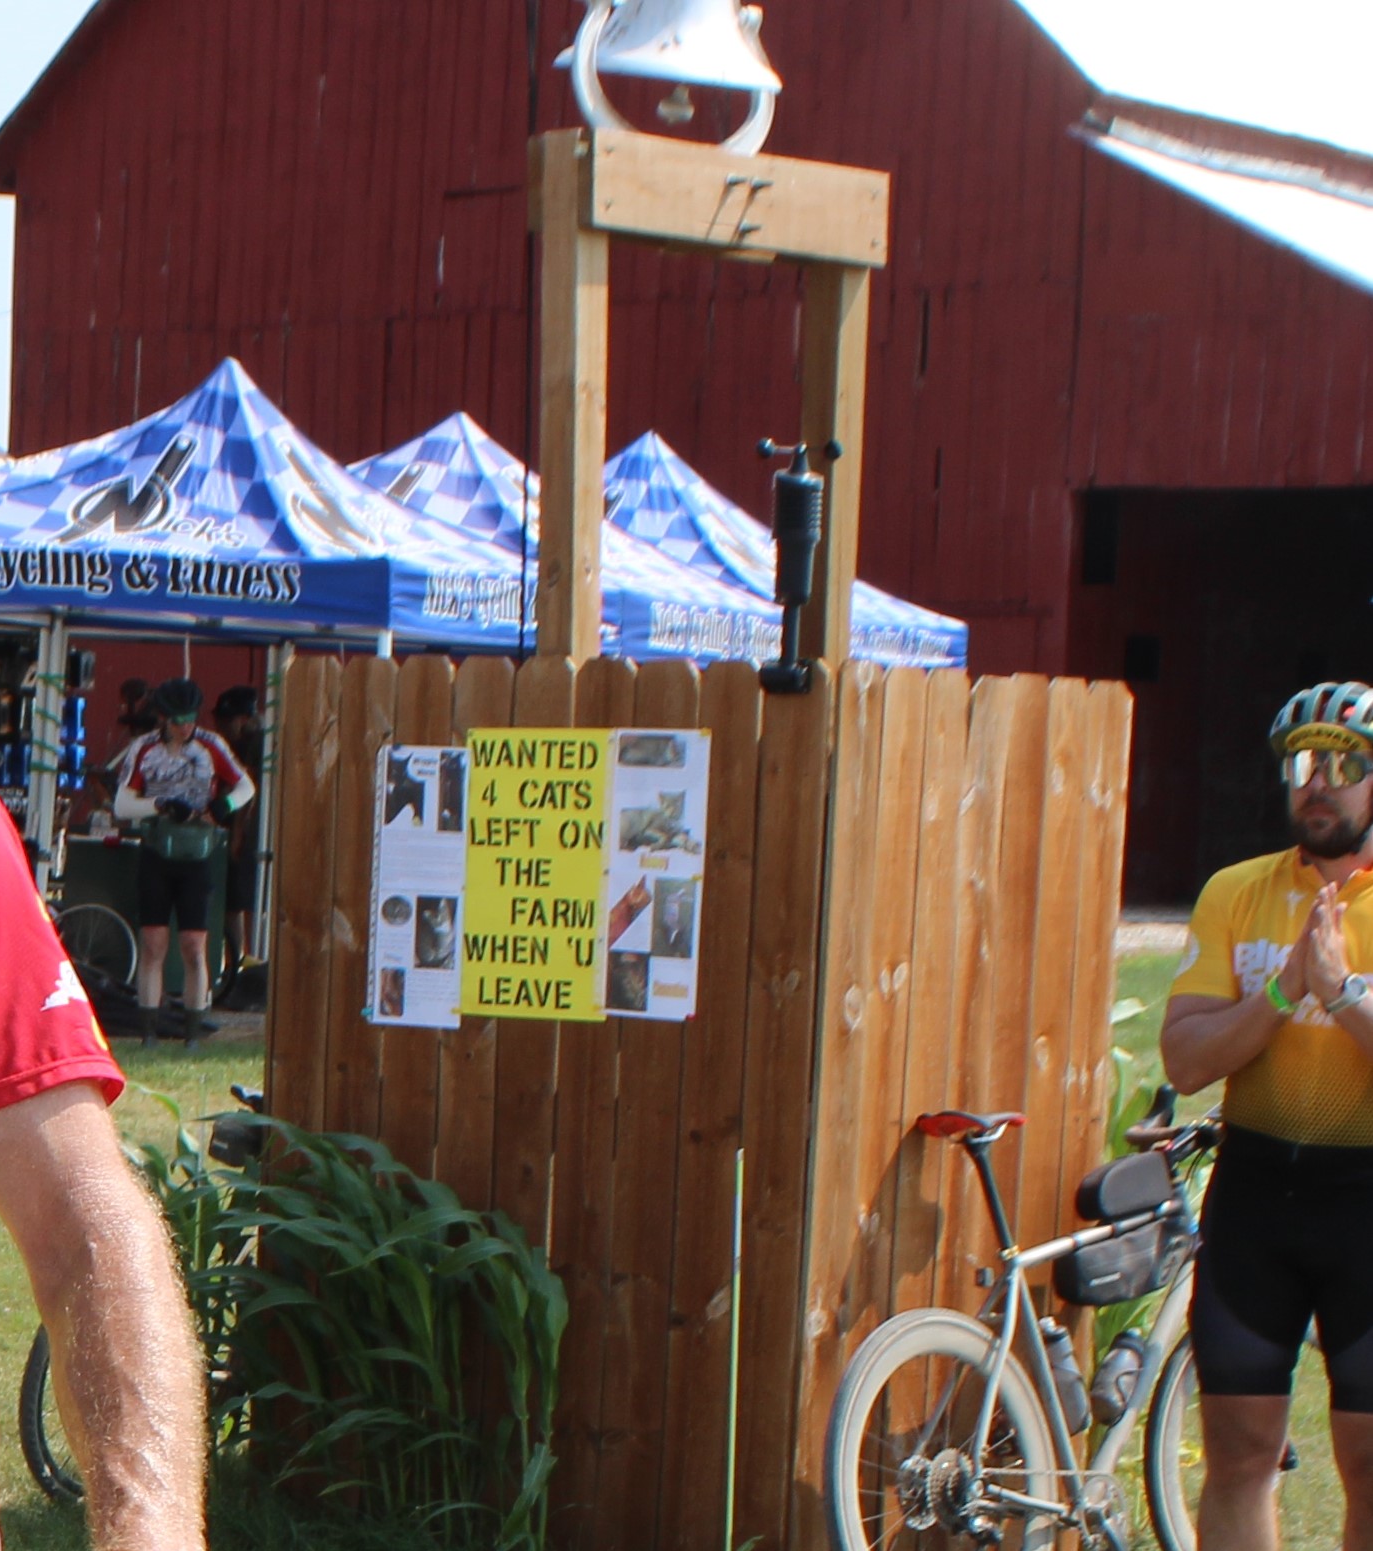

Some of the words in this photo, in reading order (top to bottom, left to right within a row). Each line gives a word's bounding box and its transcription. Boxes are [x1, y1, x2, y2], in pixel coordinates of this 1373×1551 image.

[122, 553, 157, 592] &
[166, 556, 302, 605] Fitness
[472, 738, 599, 771] WANTED
[482, 779, 498, 807] 4
[518, 779, 593, 810] CATS
[469, 817, 541, 849] LEFT
[558, 818, 605, 850] ON
[495, 856, 552, 889] THE
[510, 896, 595, 929] FARM
[463, 932, 549, 965] WHEN
[1233, 937, 1295, 976] BIK
[478, 976, 573, 1010] LEAVE
